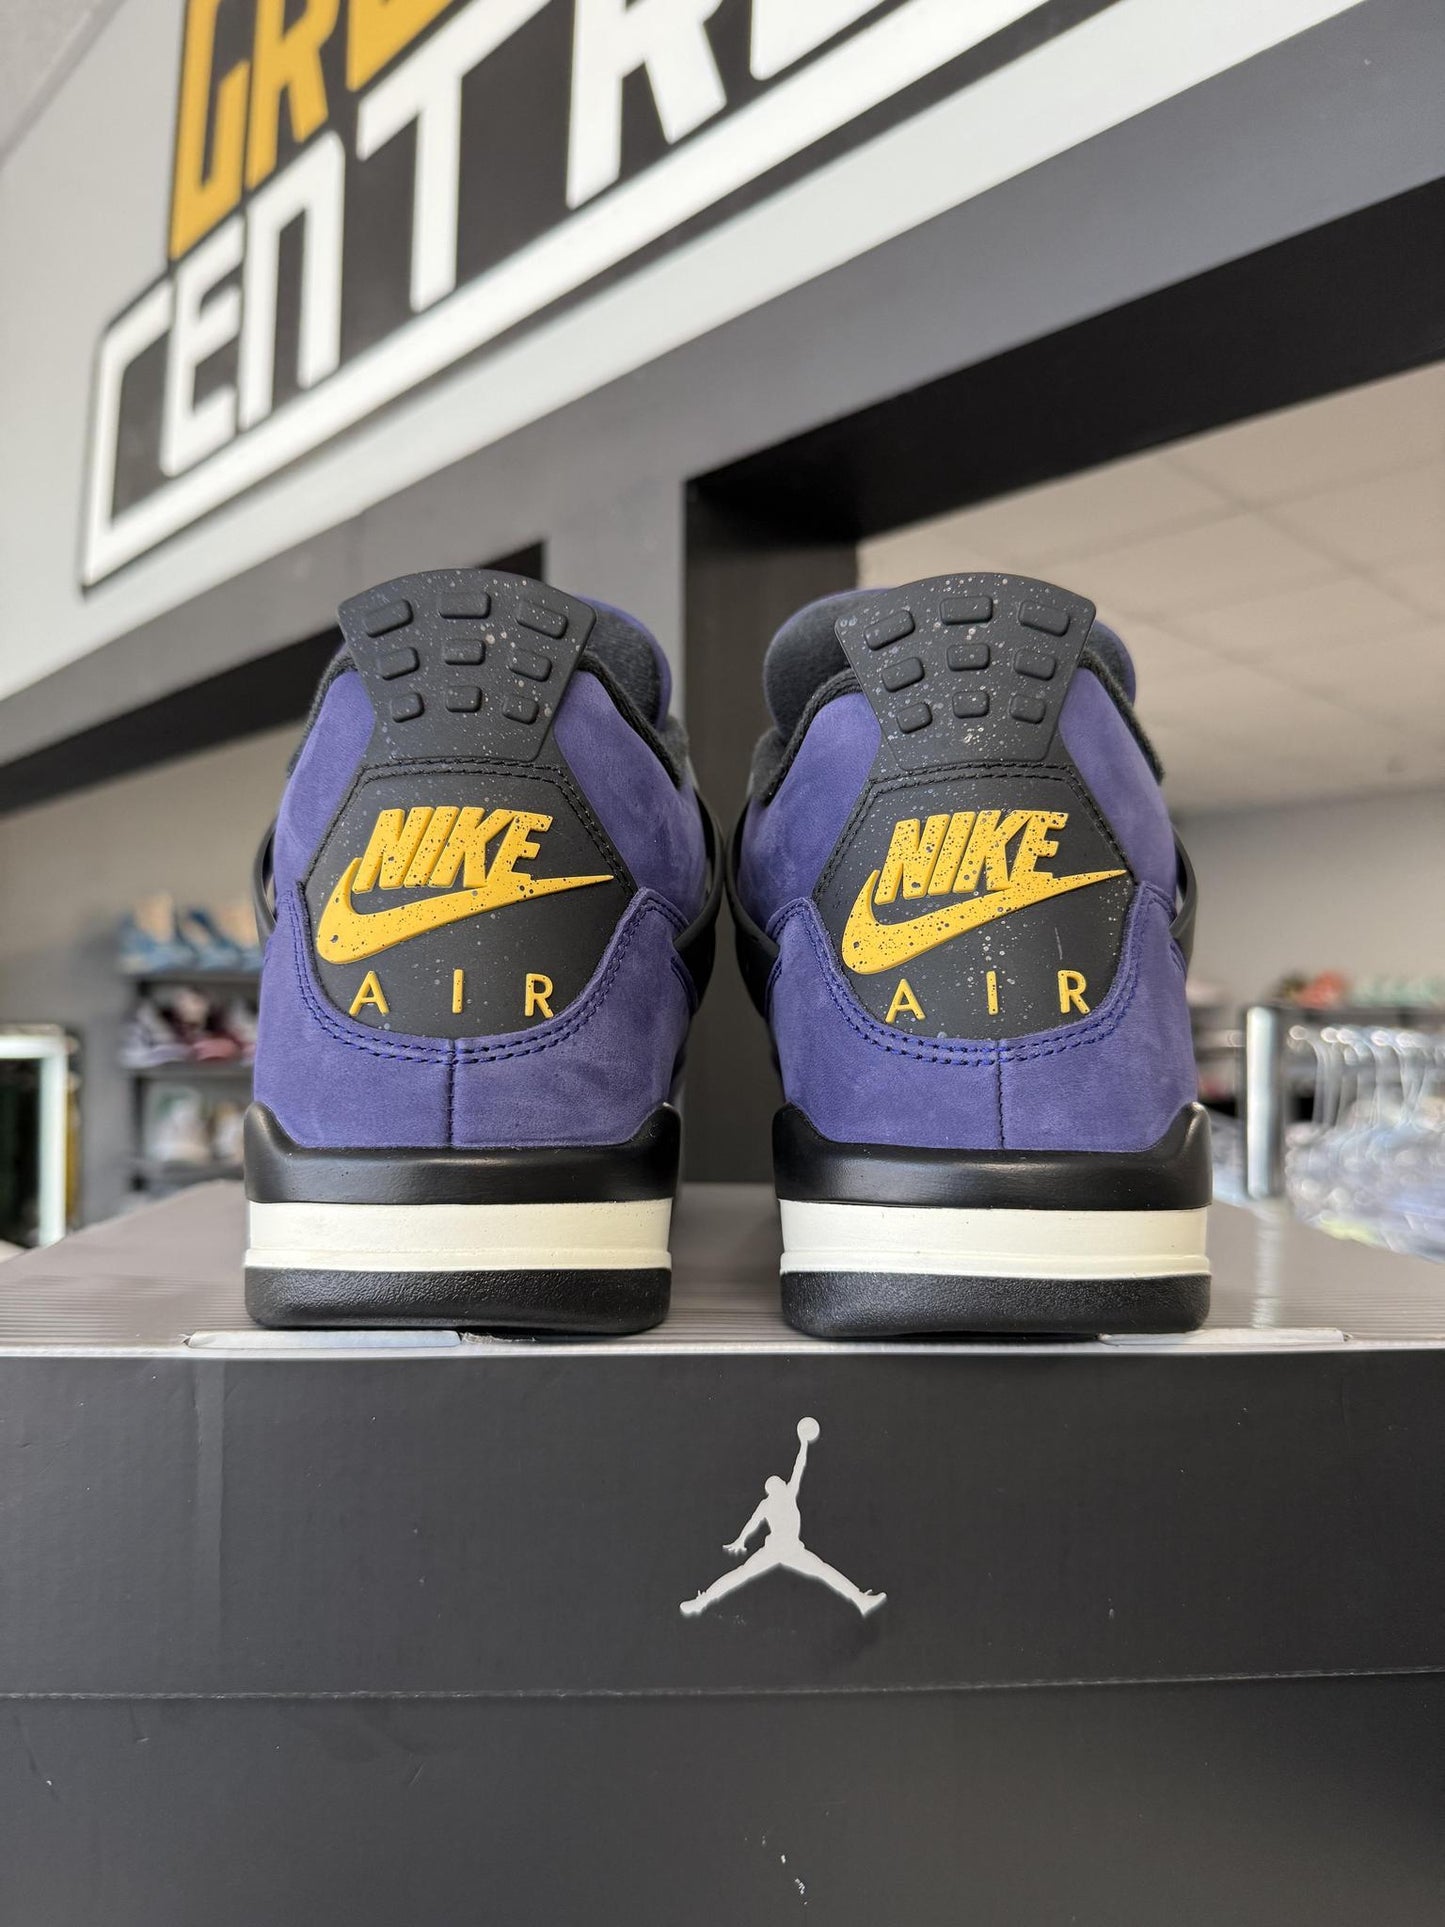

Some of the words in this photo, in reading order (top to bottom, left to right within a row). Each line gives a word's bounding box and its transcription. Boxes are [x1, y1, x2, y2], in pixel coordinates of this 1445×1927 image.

[82, 0, 890, 588] CENTR
[351, 806, 554, 895] NIKE
[874, 808, 1070, 906] NIKE
[349, 968, 555, 1019] AIR
[885, 969, 1091, 1024] AIR
